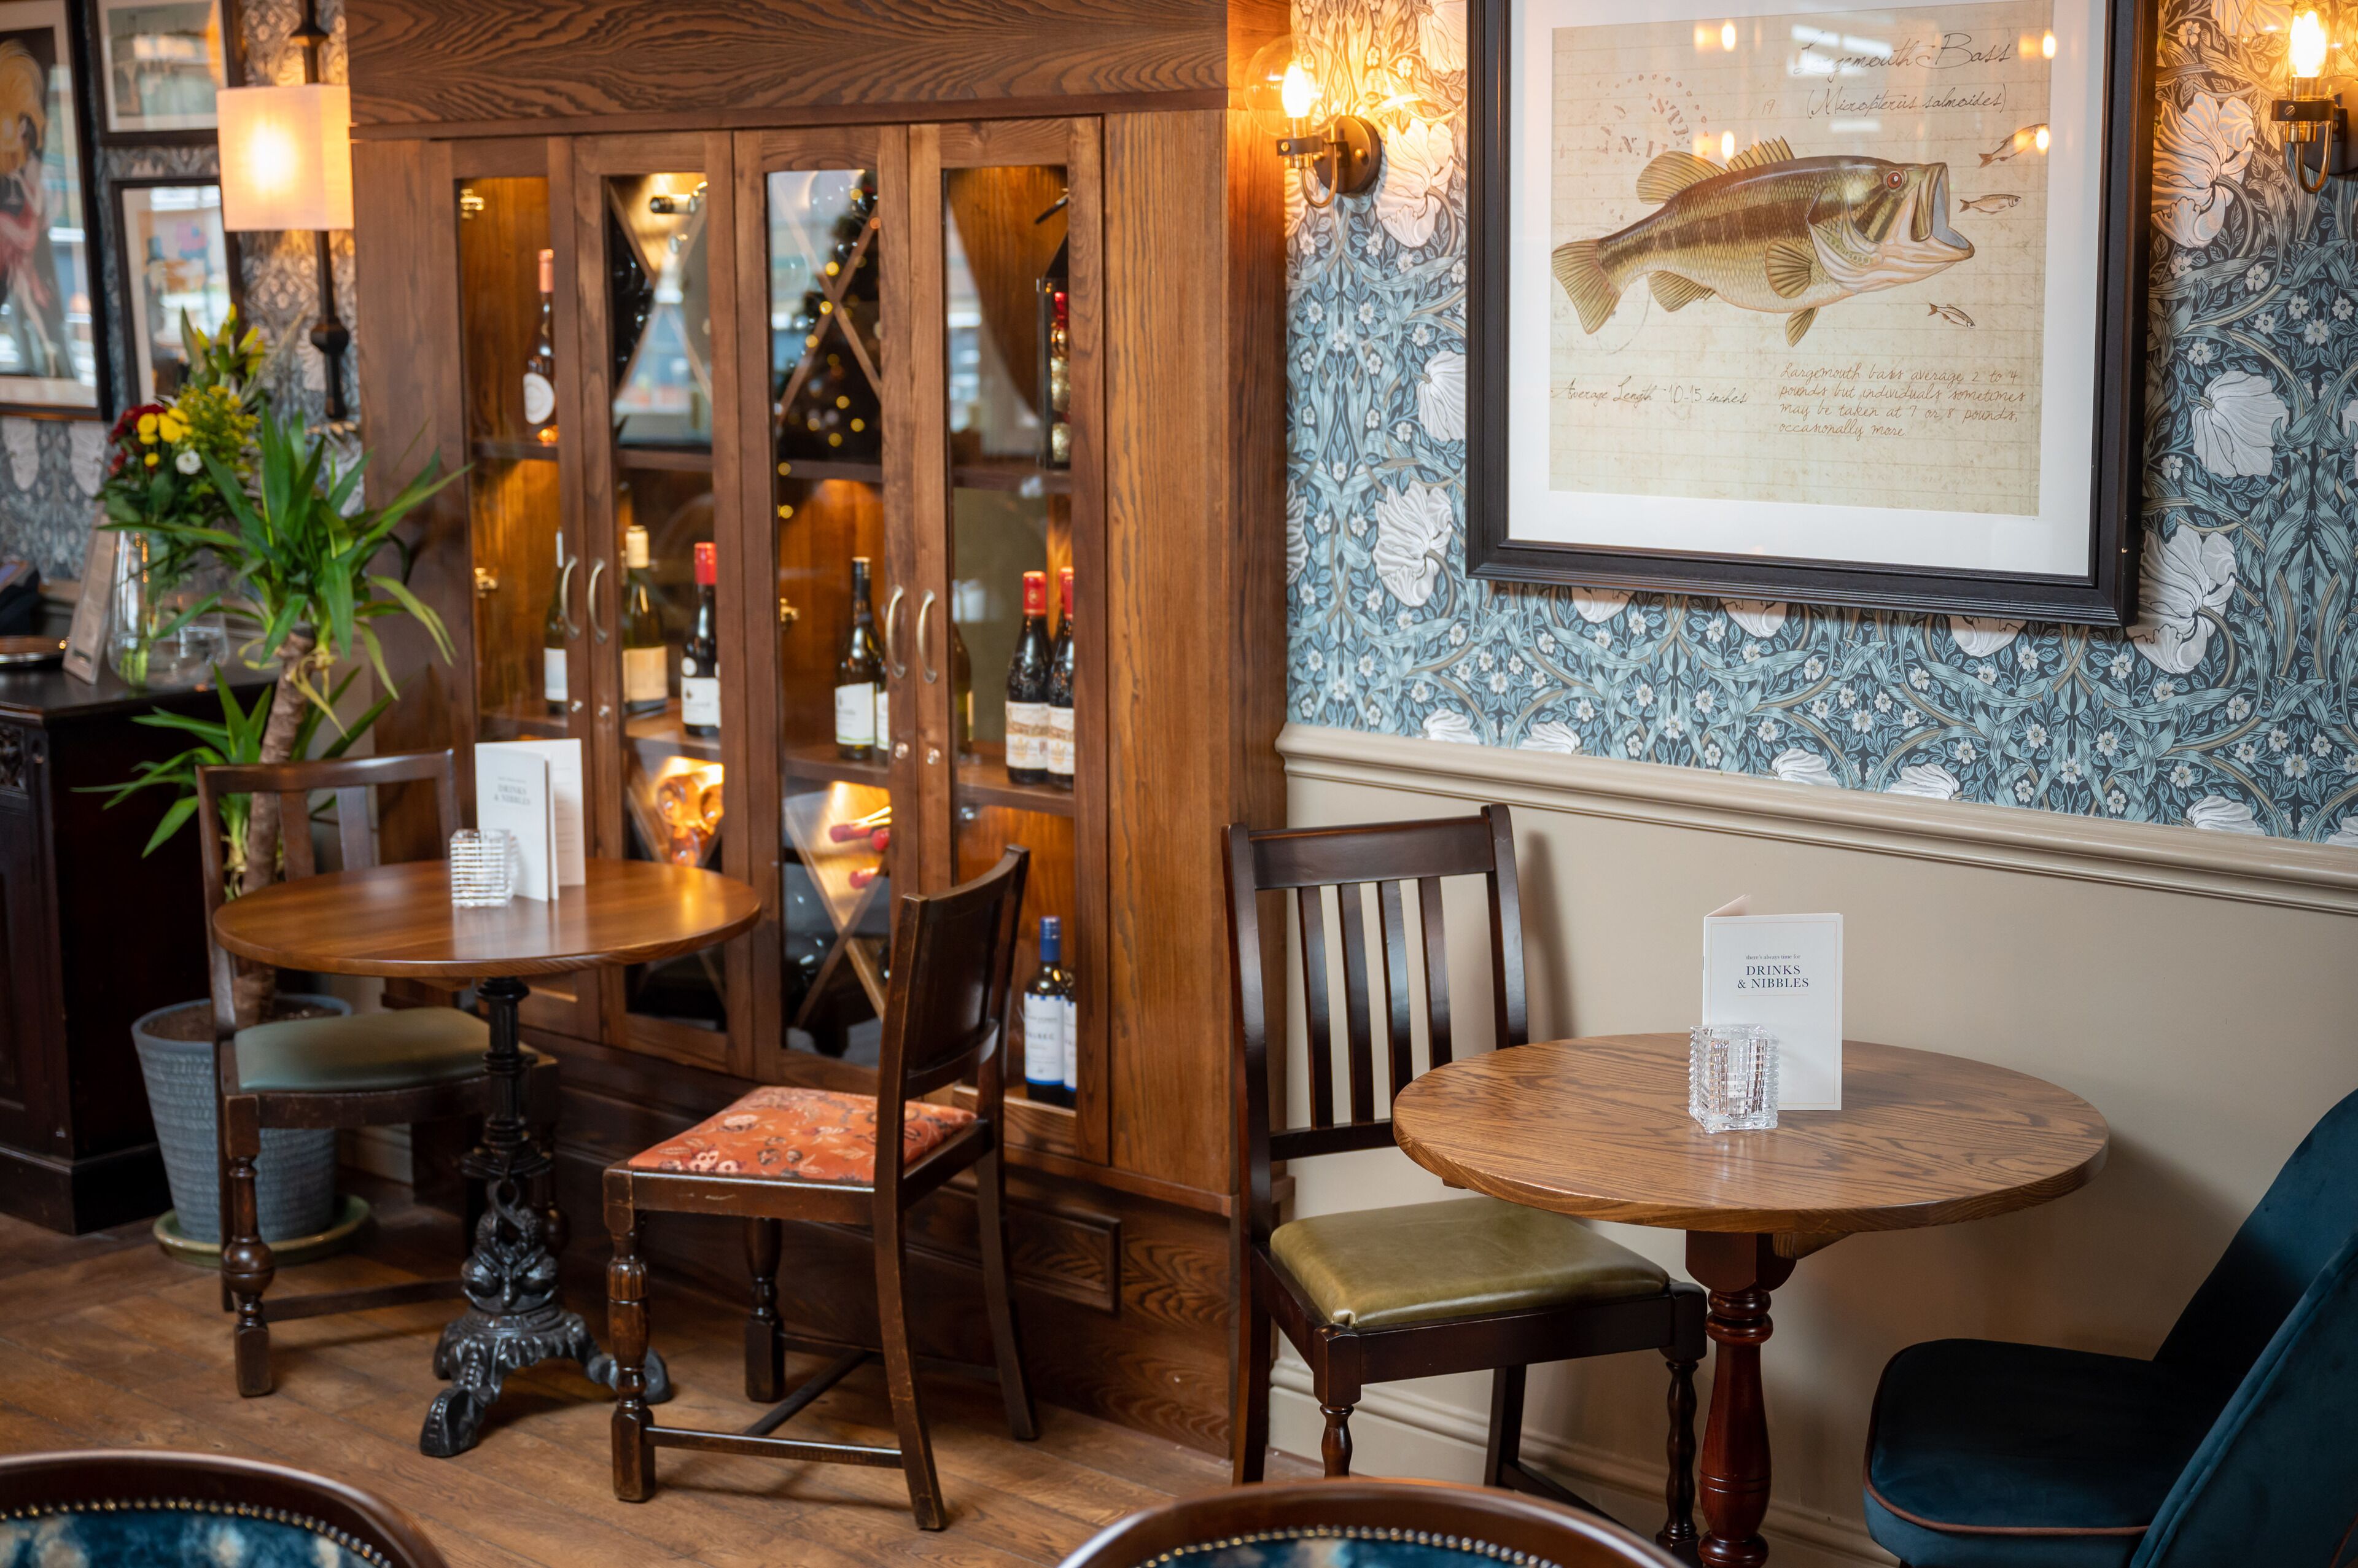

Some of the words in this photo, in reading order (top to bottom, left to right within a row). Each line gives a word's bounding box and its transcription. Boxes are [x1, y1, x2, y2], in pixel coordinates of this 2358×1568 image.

[1793, 31, 1932, 83] Largemouth
[1915, 33, 2011, 69] Bass
[1807, 85, 1918, 119] (Micropterus
[1923, 83, 2006, 114] salmoides)
[1781, 363, 1861, 384] Largemouth
[1869, 364, 1904, 379] bass
[1910, 371, 1964, 388] average
[1972, 371, 1980, 382] 2
[1990, 370, 2002, 383] to
[2009, 369, 2018, 384] 4
[1551, 378, 1608, 406] Average
[1613, 375, 1663, 408] Length
[1669, 383, 1702, 404] 10-15
[1706, 387, 1748, 403] inches
[1779, 382, 1826, 399] pounds
[1834, 383, 1856, 397] but
[1862, 385, 1941, 400] individuals
[1948, 390, 2026, 402] sometimes
[1780, 403, 1810, 421] may
[1818, 402, 1832, 415] be
[1839, 402, 1878, 417] taken
[1886, 406, 1901, 418] at
[1910, 406, 1917, 417] 7
[1925, 410, 1940, 419] or
[1947, 408, 1953, 419] 8
[1962, 409, 2018, 424] pounds,
[1778, 420, 1864, 441] occasionally
[1872, 425, 1907, 437] more.
[1746, 964, 1800, 976] DRINKS
[1737, 979, 1746, 988] &
[1751, 977, 1809, 988] NIBBLES
